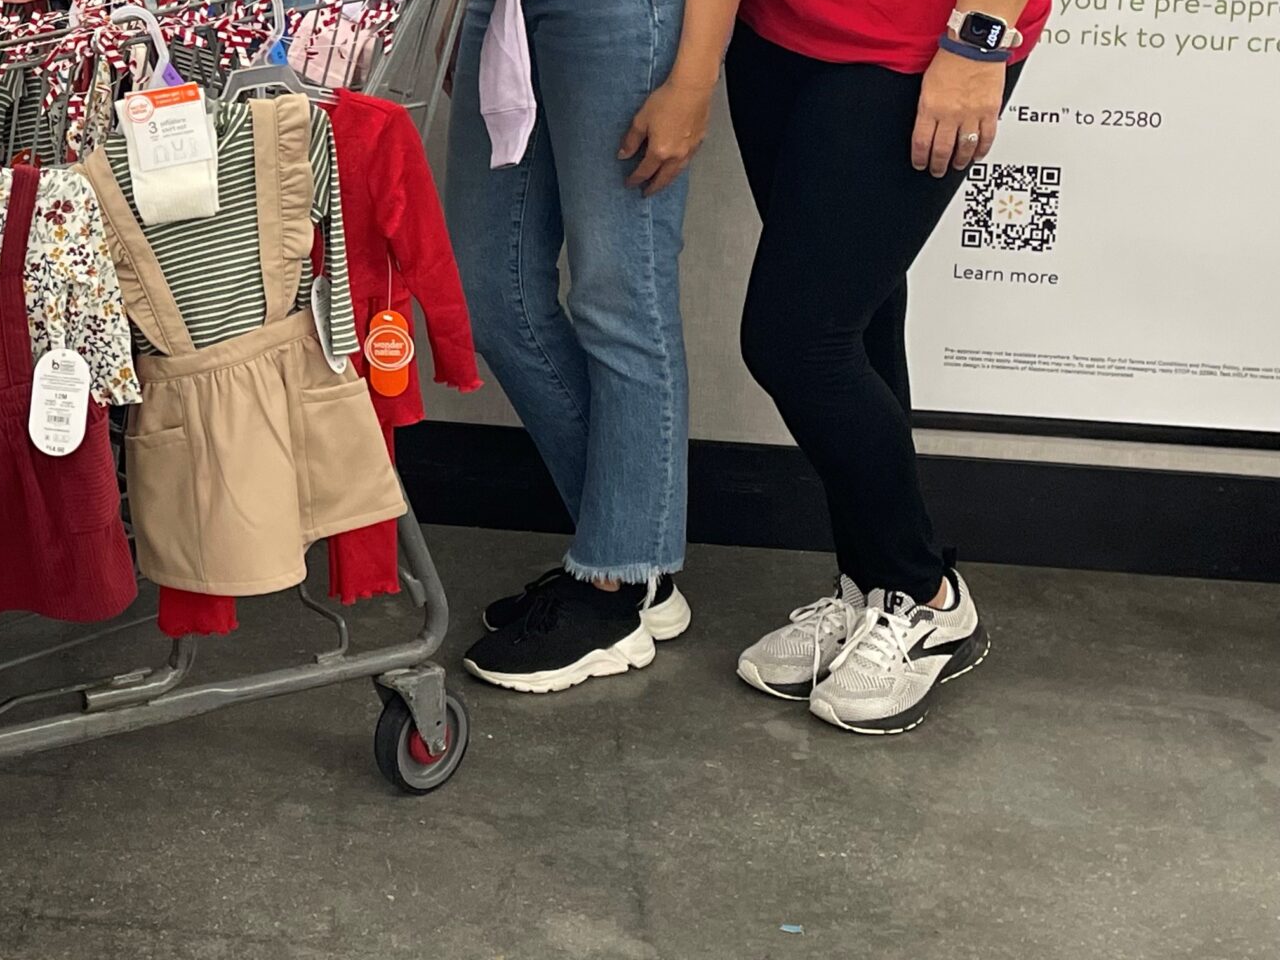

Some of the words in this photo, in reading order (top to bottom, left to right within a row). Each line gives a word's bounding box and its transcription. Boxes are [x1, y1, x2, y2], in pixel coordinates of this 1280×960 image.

[1039, 27, 1071, 44] no
[1081, 24, 1127, 47] risk
[1137, 28, 1165, 48] to
[1175, 34, 1239, 56] your
[1247, 37, 1280, 54] cr
[149, 121, 158, 134] 3
[1075, 110, 1095, 125] to
[1100, 110, 1162, 128] 22580
[953, 264, 1004, 282] Learn
[1010, 270, 1059, 285] more
